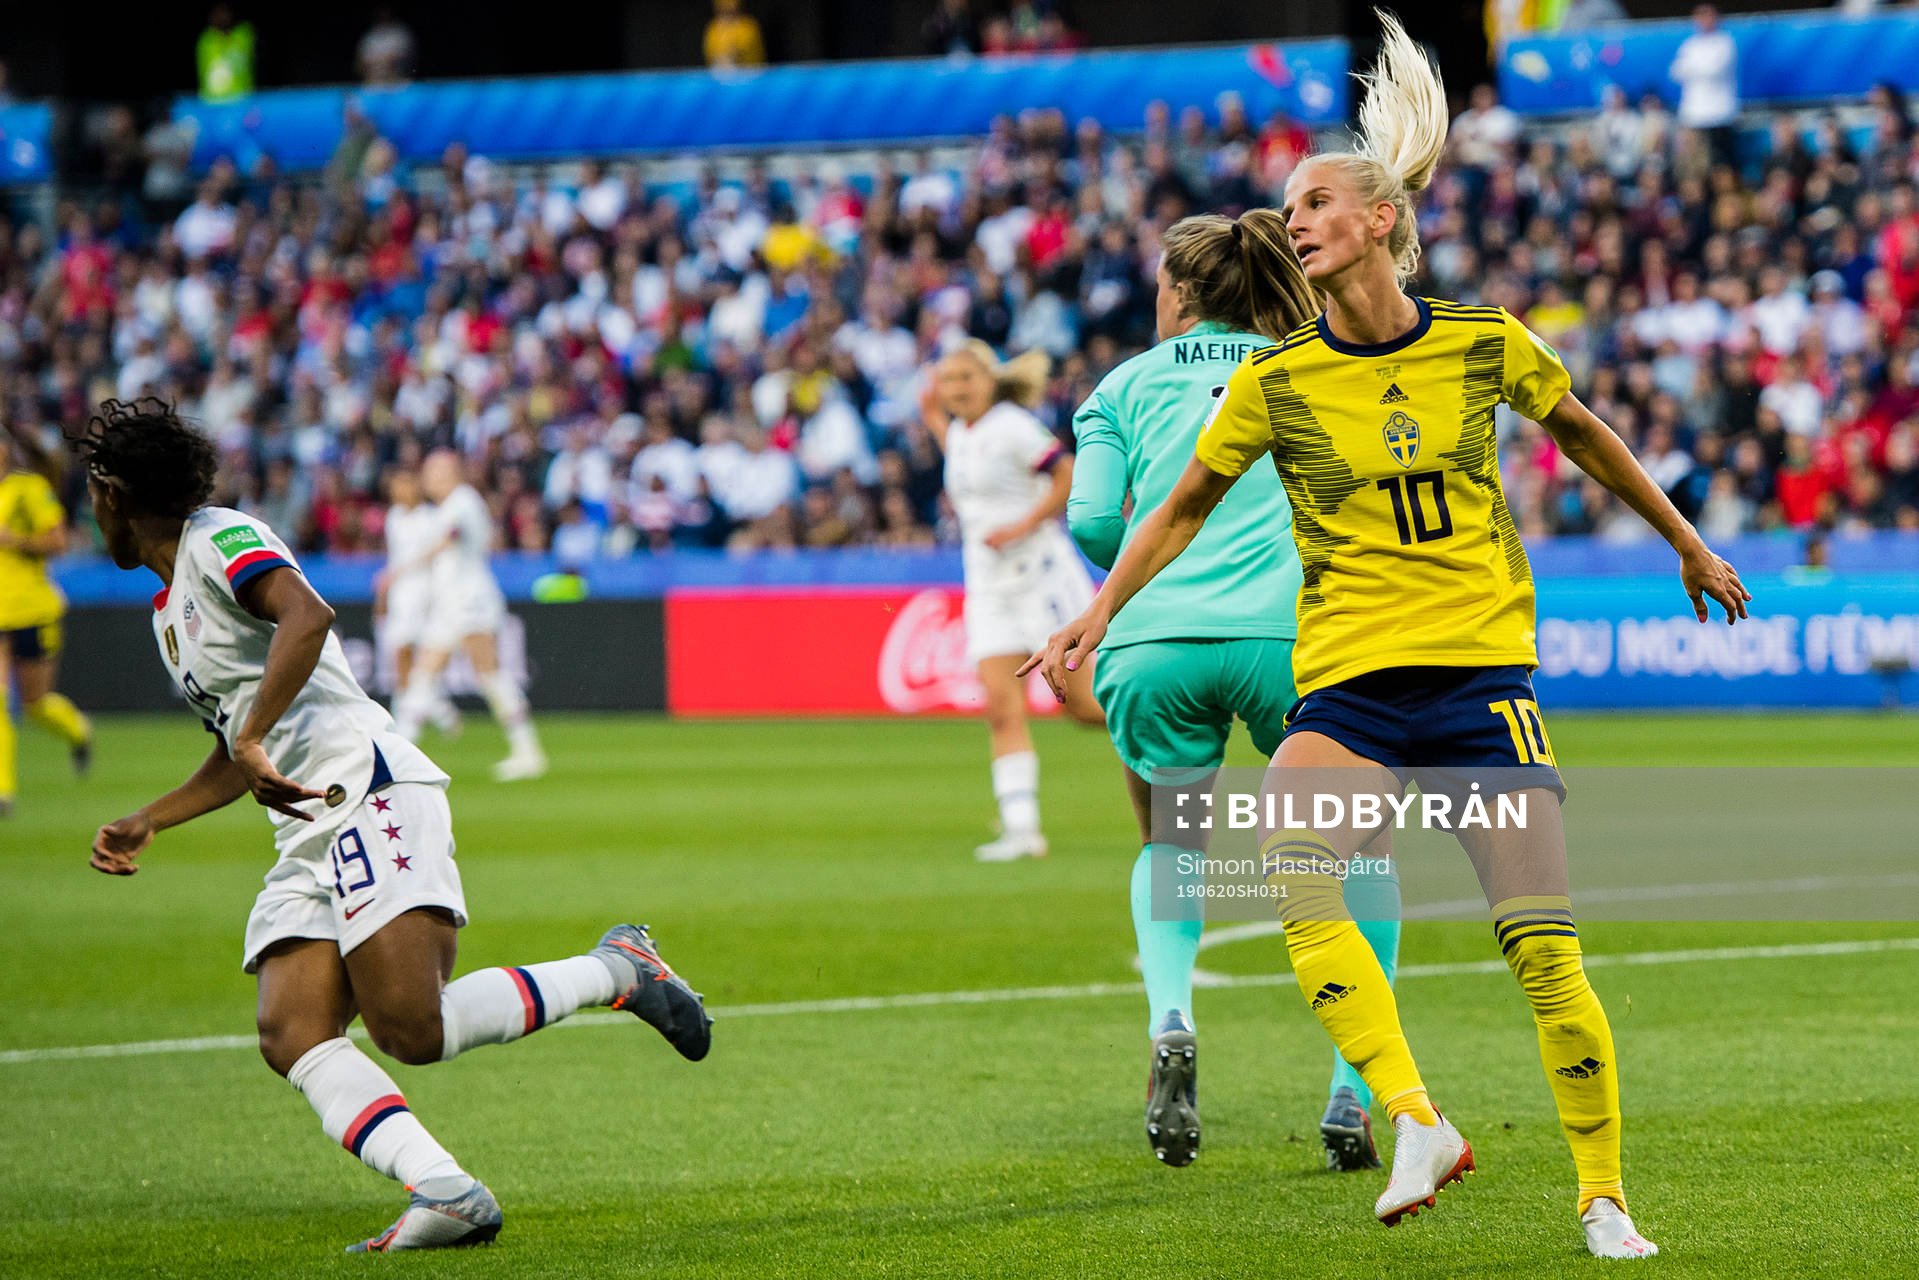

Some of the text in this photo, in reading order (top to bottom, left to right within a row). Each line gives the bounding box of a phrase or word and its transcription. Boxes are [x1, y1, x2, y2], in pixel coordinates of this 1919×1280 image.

[1174, 342, 1259, 364] NAEHE
[1379, 394, 1409, 405] adidas
[1377, 471, 1454, 545] 10
[1617, 613, 1800, 681] MONDE
[1488, 698, 1554, 767] 10
[331, 826, 376, 899] 19
[1311, 984, 1357, 1011] adidas
